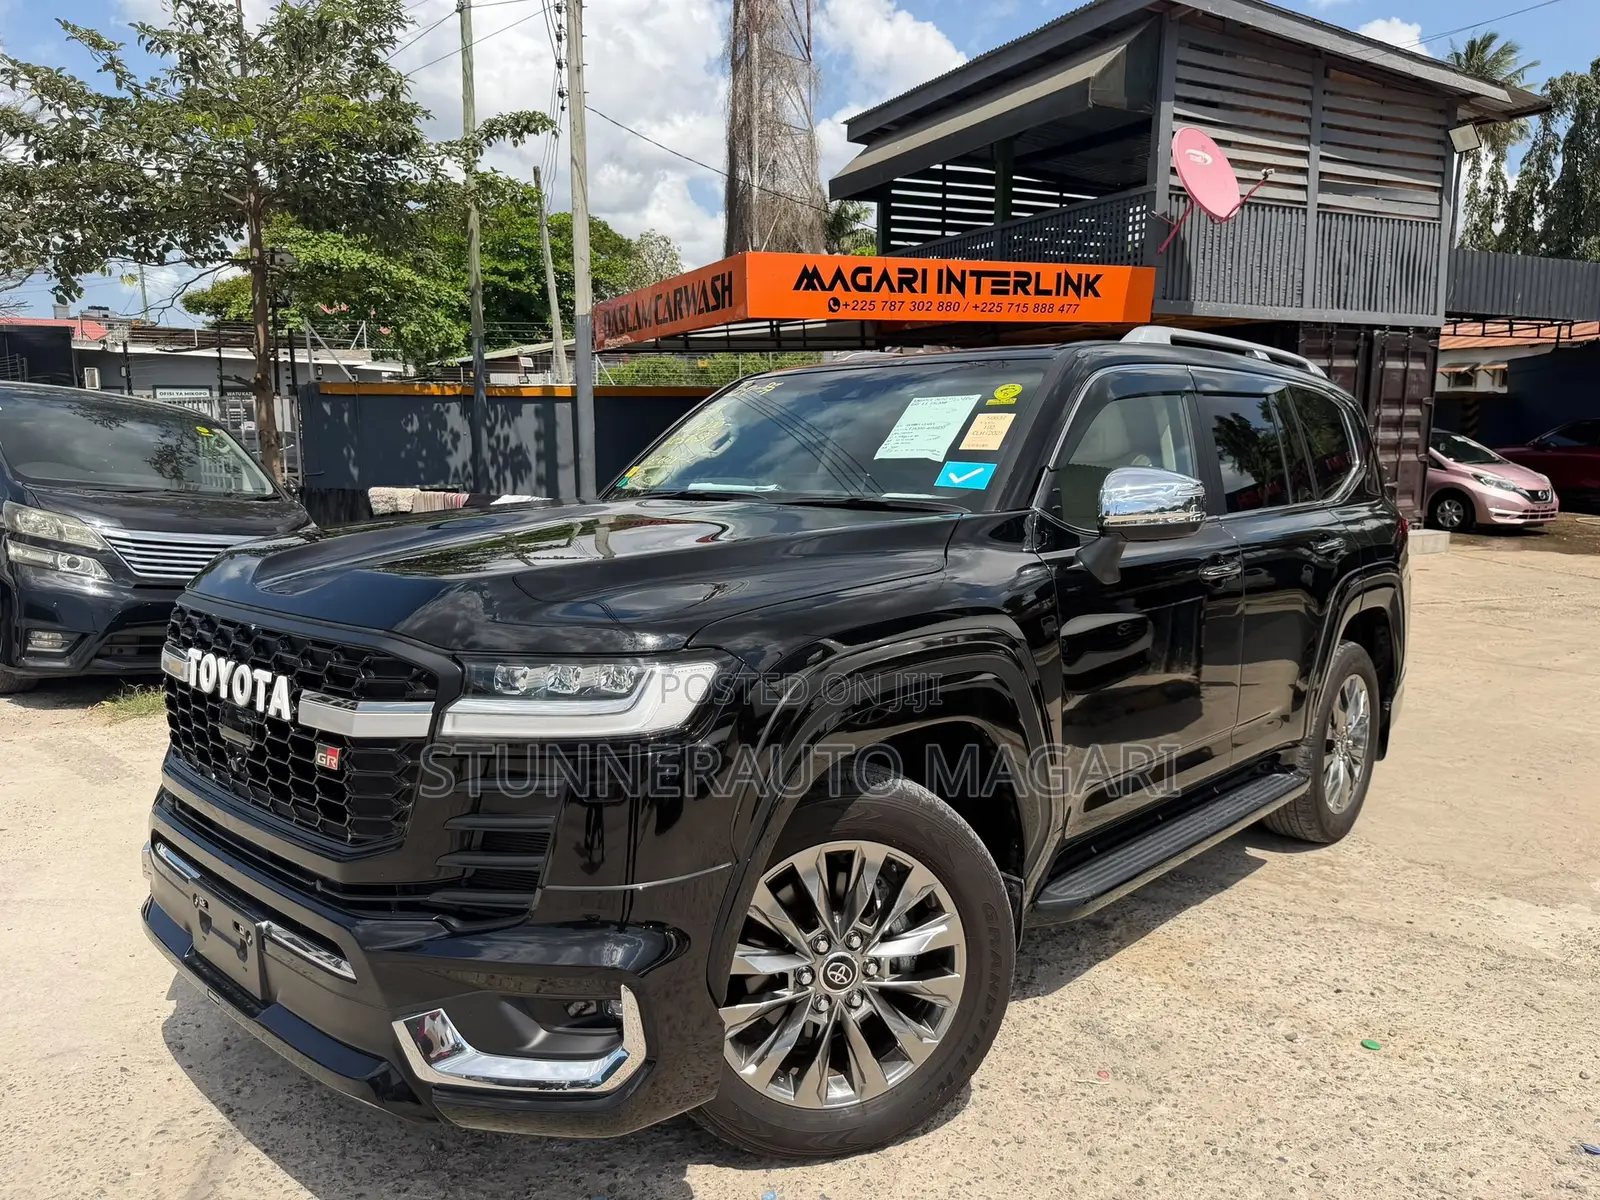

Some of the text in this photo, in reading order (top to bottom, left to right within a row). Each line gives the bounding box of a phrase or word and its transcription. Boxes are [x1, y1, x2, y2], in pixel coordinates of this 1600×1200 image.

[654, 270, 733, 326] CARWASH
[792, 264, 1105, 300] MAGARI INTERLINK
[841, 300, 876, 312] +225
[881, 300, 905, 312] 787
[909, 300, 933, 313] 302
[937, 301, 961, 313] 880
[972, 302, 1003, 313] +225
[1006, 303, 1029, 314] 715
[1032, 303, 1055, 314] 888
[1057, 304, 1081, 315] 477
[187, 648, 291, 720] TOYOTA
[316, 751, 338, 769] GR
